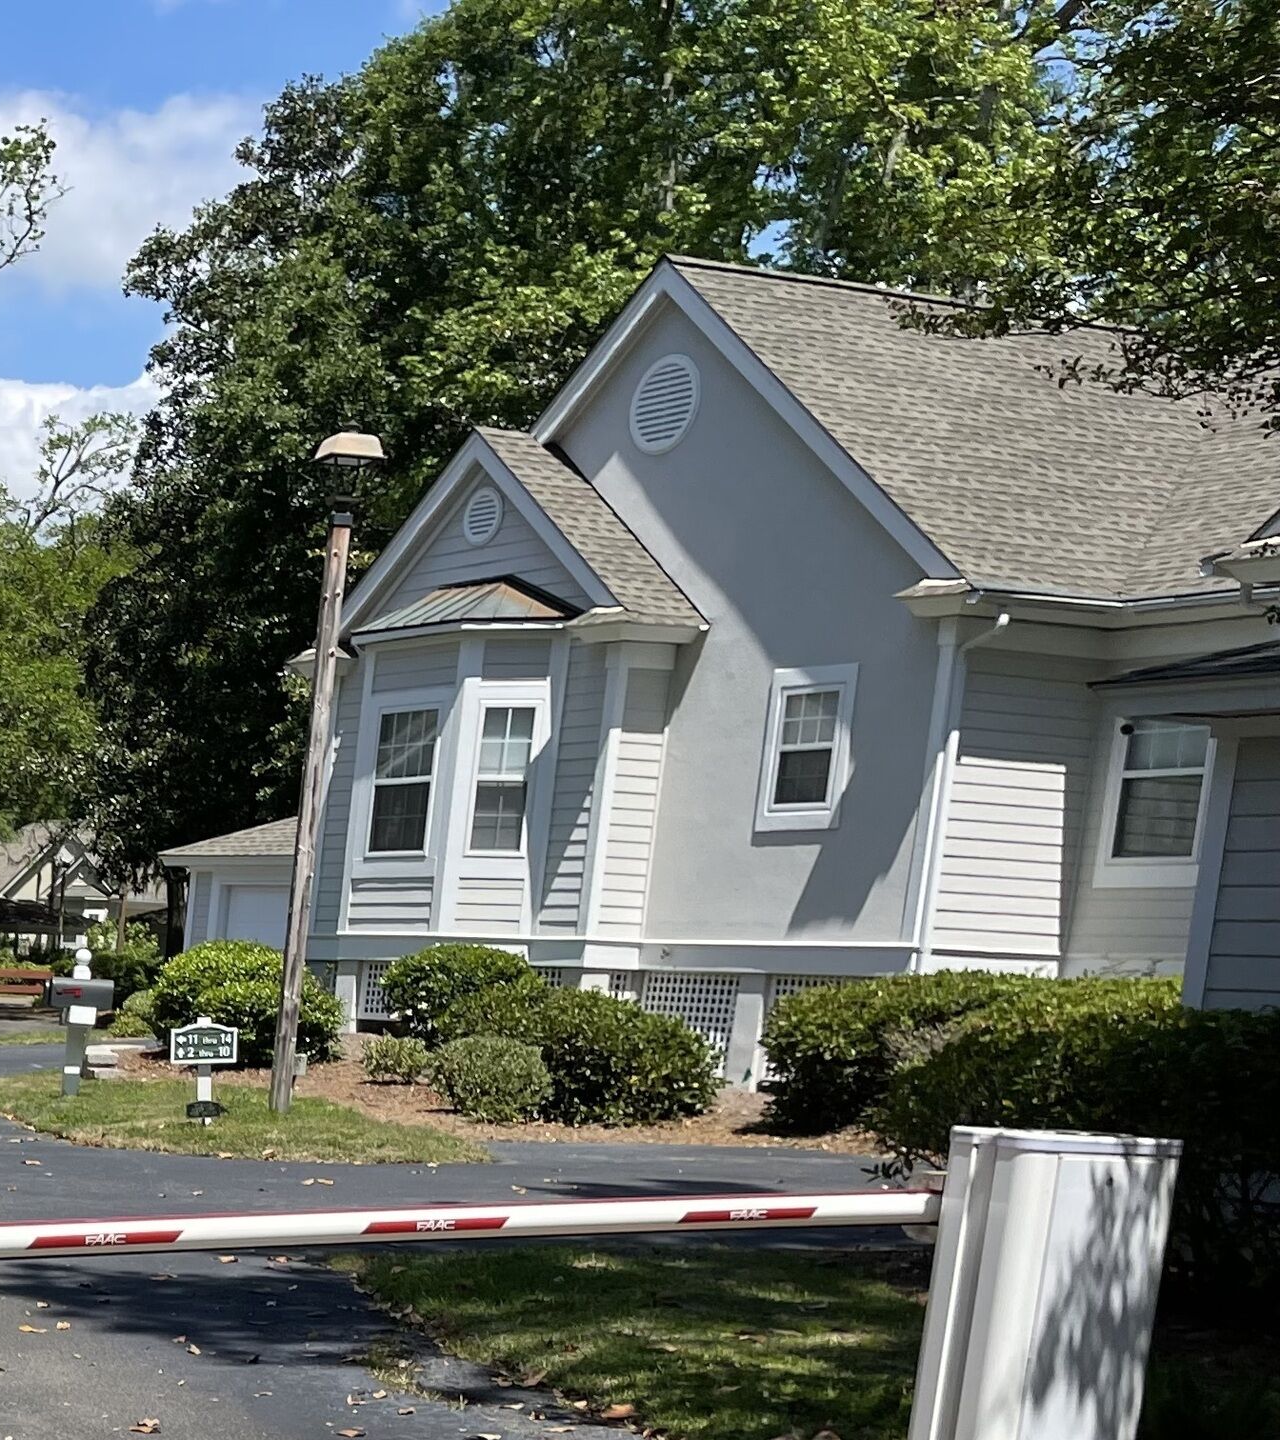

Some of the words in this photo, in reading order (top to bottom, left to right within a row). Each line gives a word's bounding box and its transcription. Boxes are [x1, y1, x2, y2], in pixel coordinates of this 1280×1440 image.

[187, 1033, 199, 1045] 11
[202, 1036, 218, 1045] thru
[220, 1033, 232, 1045] 14
[187, 1046, 195, 1058] 2
[198, 1048, 214, 1058] thru
[218, 1045, 231, 1057] 10
[729, 1208, 768, 1221] FAAC
[416, 1218, 456, 1232] FAAC
[84, 1233, 127, 1246] FAAC
